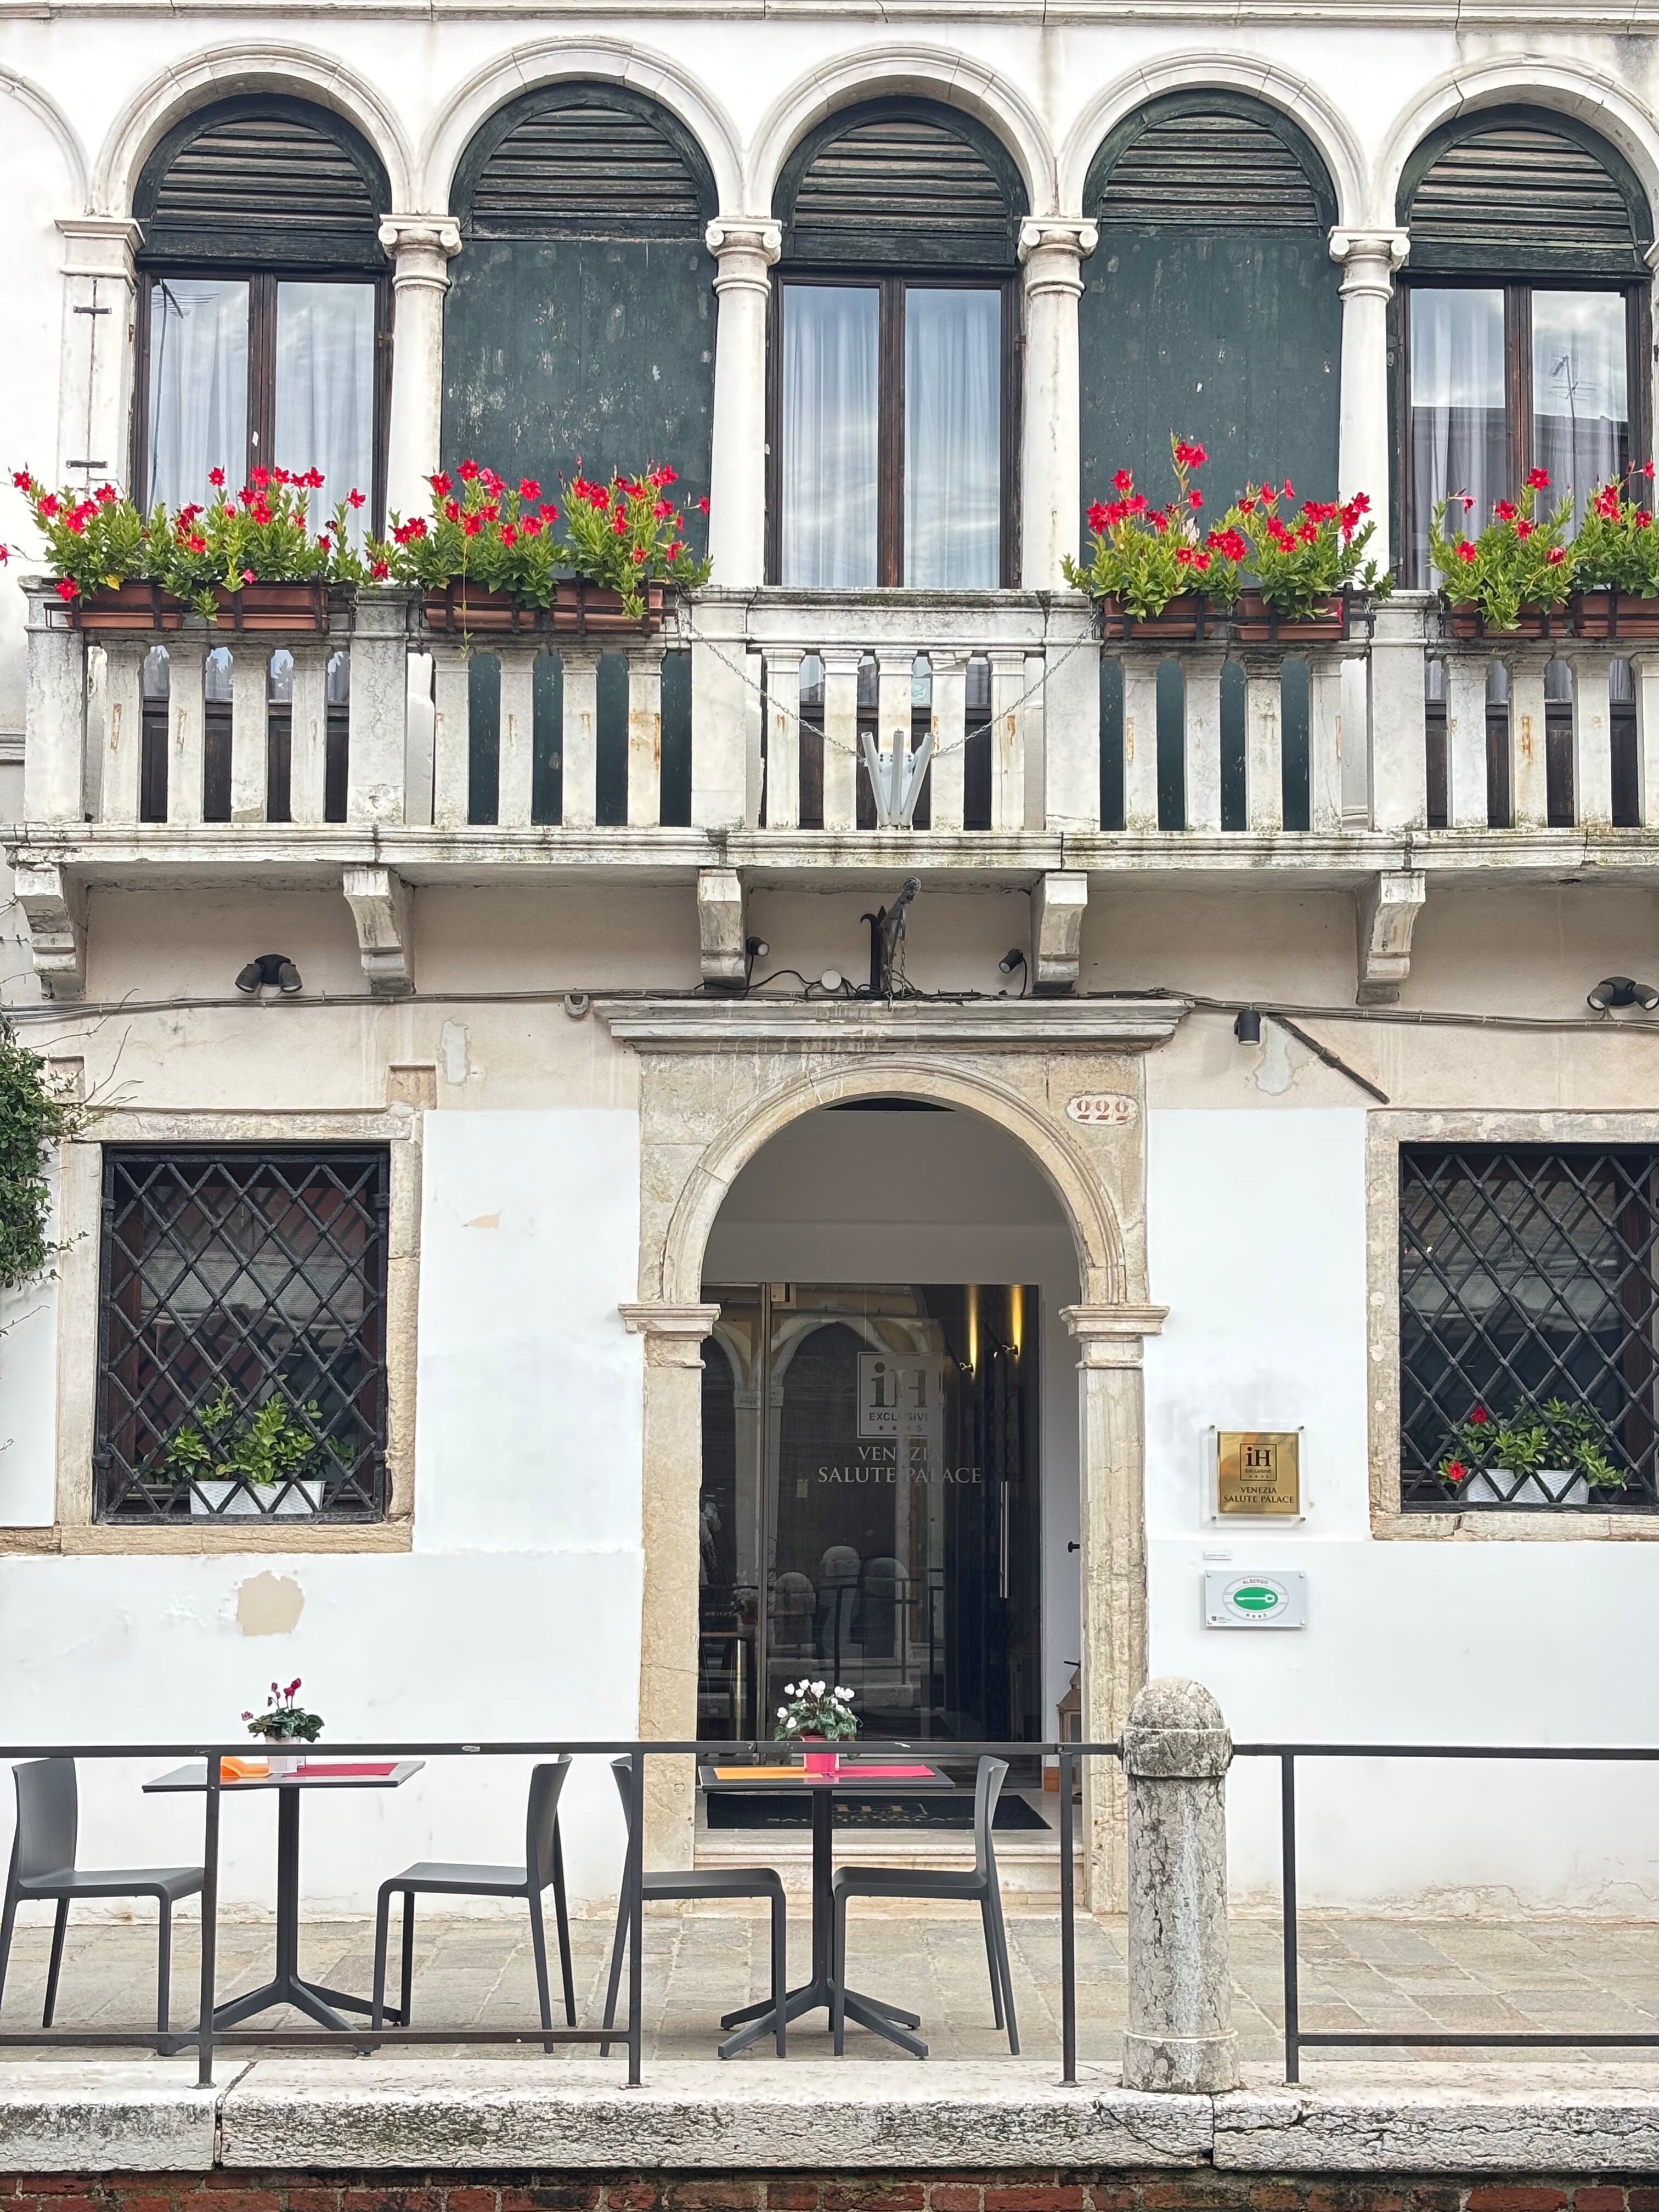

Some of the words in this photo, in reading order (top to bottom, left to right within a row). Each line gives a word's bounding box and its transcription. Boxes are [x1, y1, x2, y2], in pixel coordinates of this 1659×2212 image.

[1076, 1099, 1129, 1121] 222
[869, 1413, 929, 1421] EXCLSIV
[857, 1447, 942, 1461] VENZIA
[1245, 1446, 1272, 1466] iH
[818, 1466, 896, 1482] SALUTE
